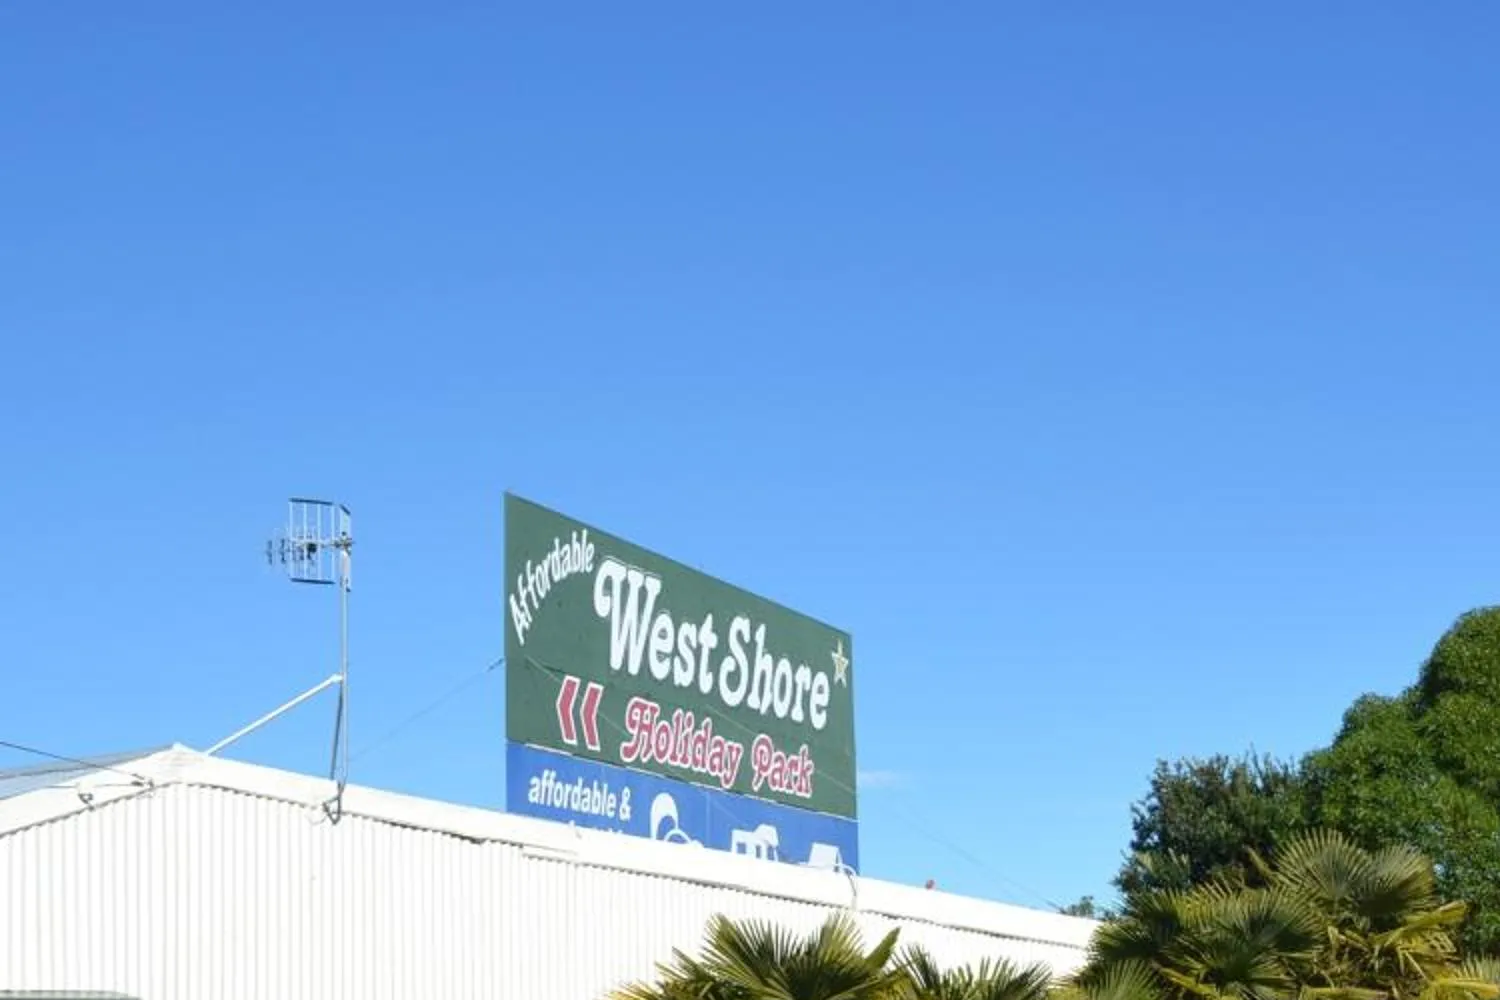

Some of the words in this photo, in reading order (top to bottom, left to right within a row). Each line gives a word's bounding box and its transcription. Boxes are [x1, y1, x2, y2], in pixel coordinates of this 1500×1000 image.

[509, 528, 595, 646] Affordable
[528, 769, 617, 818] affordable
[619, 786, 631, 821] &
[621, 697, 743, 790] Holiday
[751, 734, 814, 799] Park
